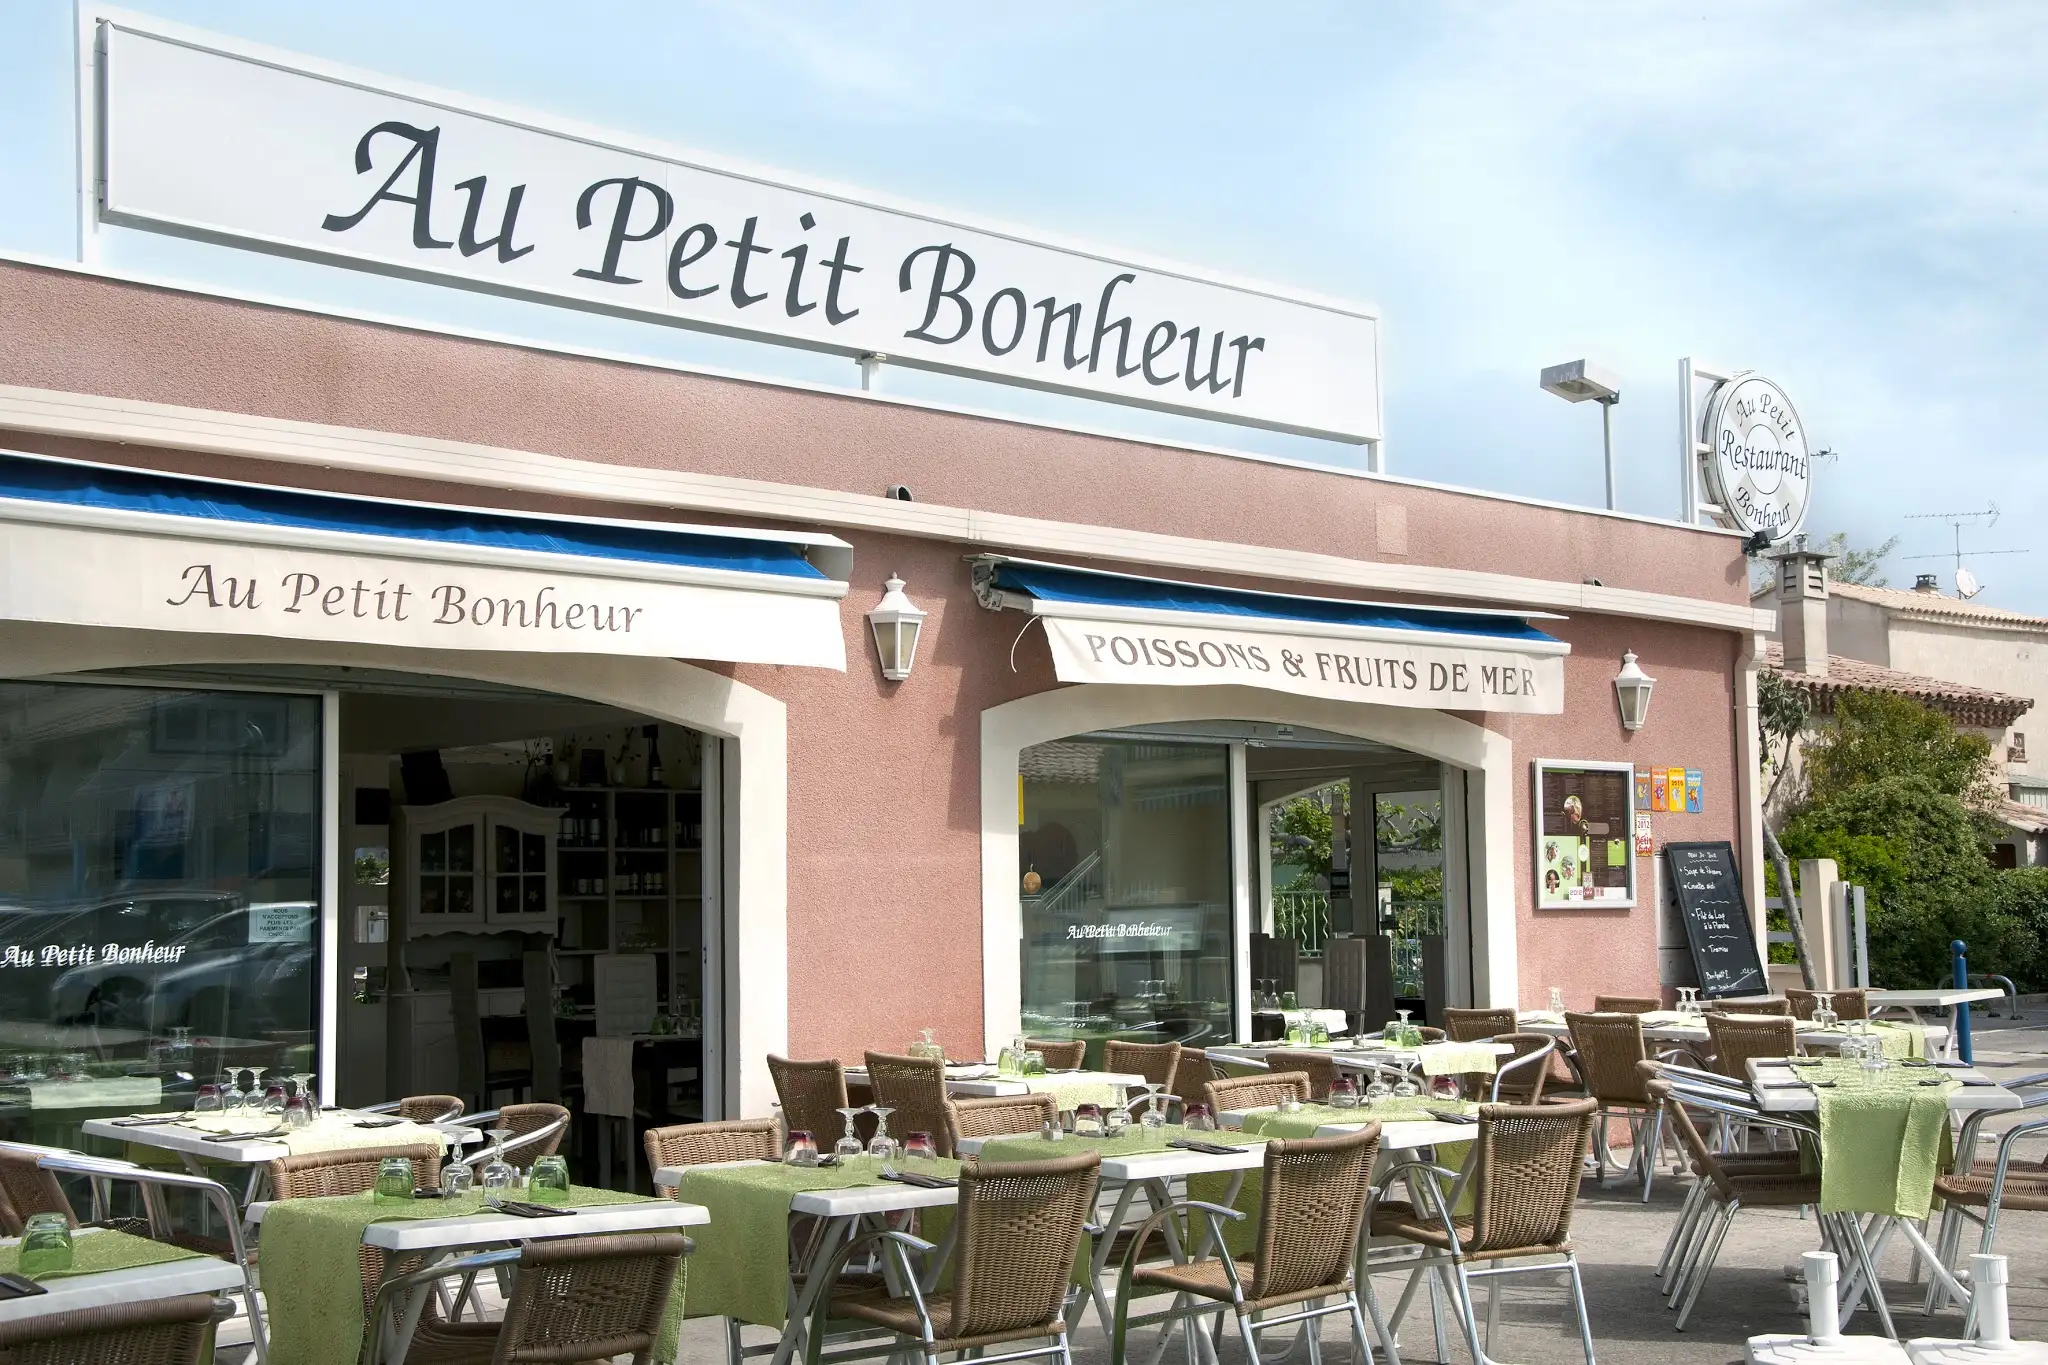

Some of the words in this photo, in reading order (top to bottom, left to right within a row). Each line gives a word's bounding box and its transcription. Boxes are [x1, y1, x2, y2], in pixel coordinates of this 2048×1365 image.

[321, 121, 534, 263] Au
[573, 176, 865, 326] Petit
[898, 242, 1266, 399] Bonheur
[1736, 397, 1757, 427] Au
[1760, 393, 1795, 442] Petit
[1721, 429, 1807, 480] Restaurant
[1735, 486, 1791, 529] Bonheur
[166, 564, 263, 610] Au
[282, 573, 413, 622] Petit
[432, 586, 643, 633] Bonheur
[1083, 633, 1272, 674] POISSONS
[1282, 648, 1308, 678] &
[1315, 652, 1419, 691] FRUITS
[1429, 662, 1470, 693] DE
[1481, 665, 1537, 697] MER
[1637, 820, 1650, 829] 2012
[0, 944, 35, 968] Au
[41, 943, 95, 968] Petit
[101, 939, 186, 966] Bonheur
